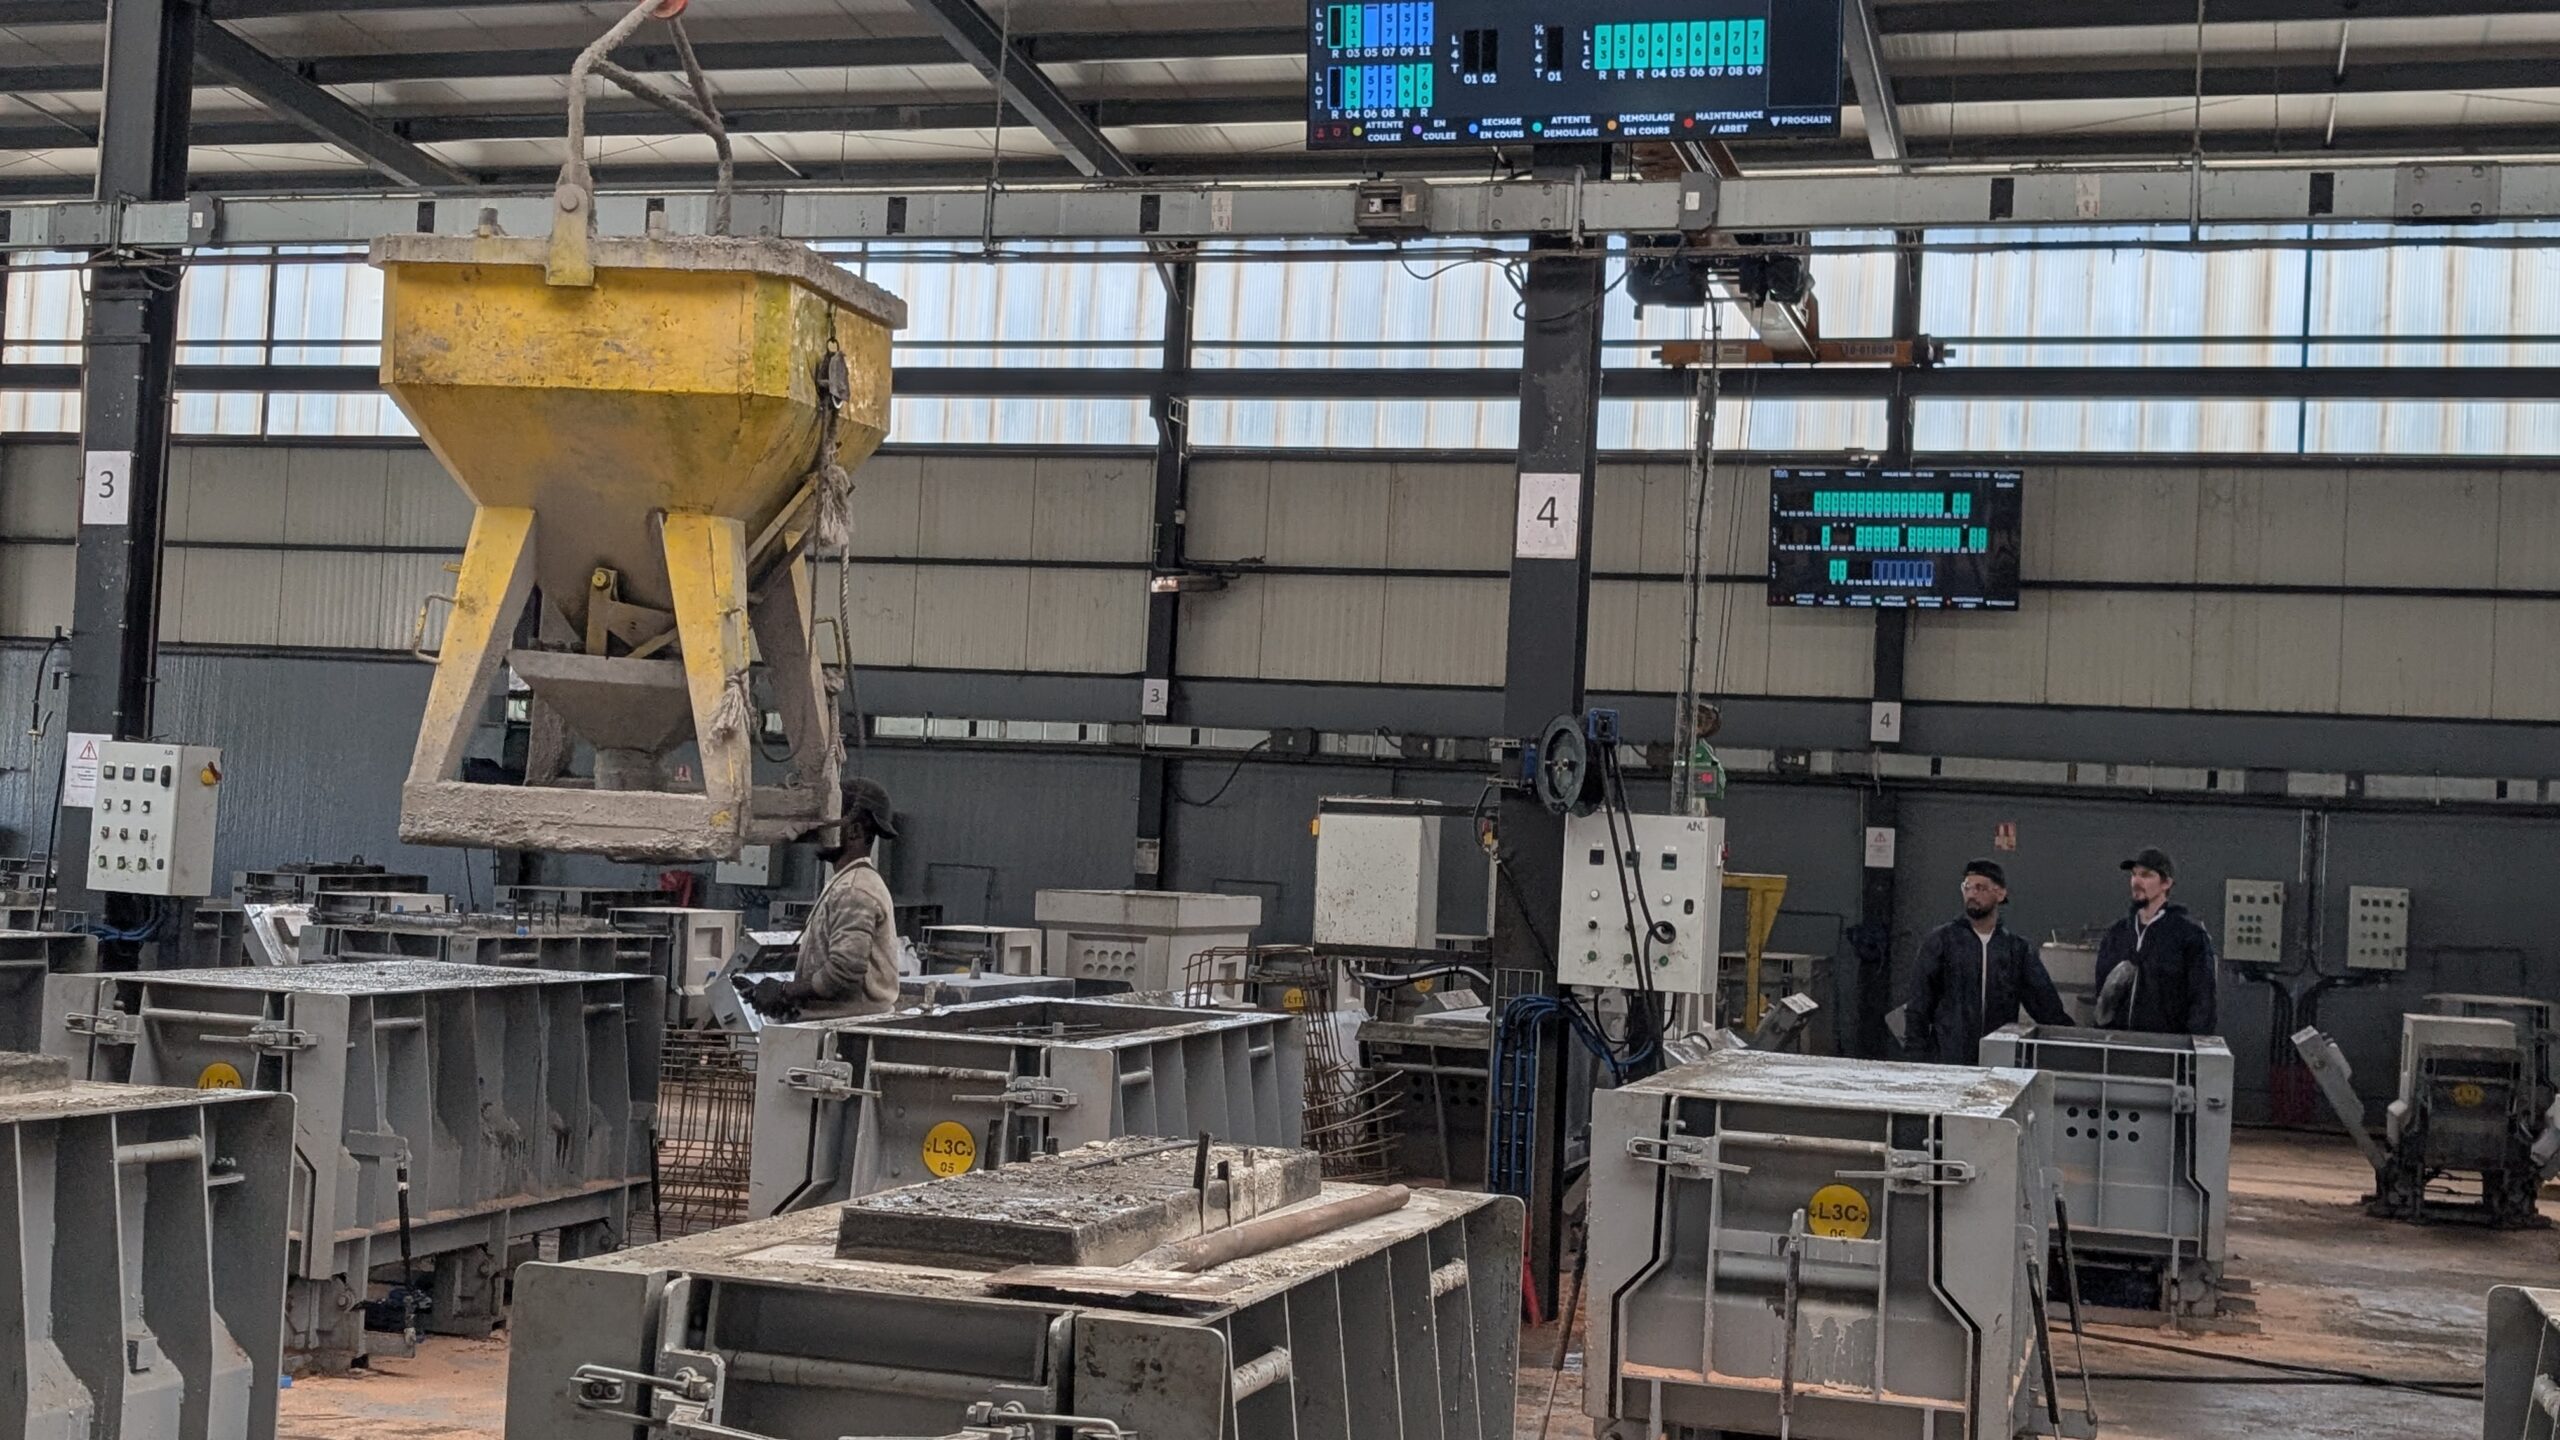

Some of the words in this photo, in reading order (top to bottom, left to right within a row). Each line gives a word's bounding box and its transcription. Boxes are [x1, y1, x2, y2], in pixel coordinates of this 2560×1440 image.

[1331, 49, 1339, 58] R
[1346, 48, 1360, 58] 03
[1364, 48, 1378, 57] 05
[1381, 47, 1396, 57] 07
[1400, 47, 1414, 56] 09
[1419, 46, 1431, 56] 11
[1582, 30, 1591, 70] L1C
[1463, 73, 1478, 84] 01
[1481, 72, 1497, 83] 02
[1547, 71, 1562, 82] 01
[1599, 70, 1607, 80] R
[1617, 70, 1626, 80] R
[1636, 69, 1645, 79] R
[1651, 69, 1667, 78] 04
[1670, 68, 1686, 78] 05
[1689, 67, 1705, 77] 06
[1708, 66, 1724, 77] 07
[1727, 66, 1743, 76] 08
[1747, 65, 1763, 75] 09
[1331, 110, 1339, 120] R
[1345, 109, 1360, 119] 04
[1363, 109, 1378, 118] 06
[1381, 109, 1396, 118] 08
[1402, 109, 1410, 118] R
[1420, 108, 1428, 117] R
[1551, 115, 1591, 124] ATTENTE
[1619, 112, 1675, 123] DEMOULAGE
[1695, 110, 1764, 121] MAINTENANCE
[1365, 120, 1404, 129] ATTENTE
[1433, 119, 1446, 128] EN
[1481, 117, 1522, 126] SECHAGE
[1781, 115, 1832, 125] PROCHAIN
[1543, 127, 1599, 138] DEMOULAGE
[1623, 127, 1637, 136] EN
[1638, 126, 1670, 135] COURS
[1718, 123, 1748, 133] ARRET
[1367, 133, 1402, 142] COULEE
[1422, 131, 1457, 141] COULEE
[1480, 131, 1492, 139] EN
[1494, 130, 1524, 139] COURS
[99, 470, 114, 499] 3
[1536, 496, 1559, 529] 4
[1151, 688, 1160, 703] 3
[1880, 712, 1892, 728] 4
[933, 1137, 966, 1156] L3C
[940, 1161, 954, 1173] 05
[1819, 1202, 1859, 1222] L3C
